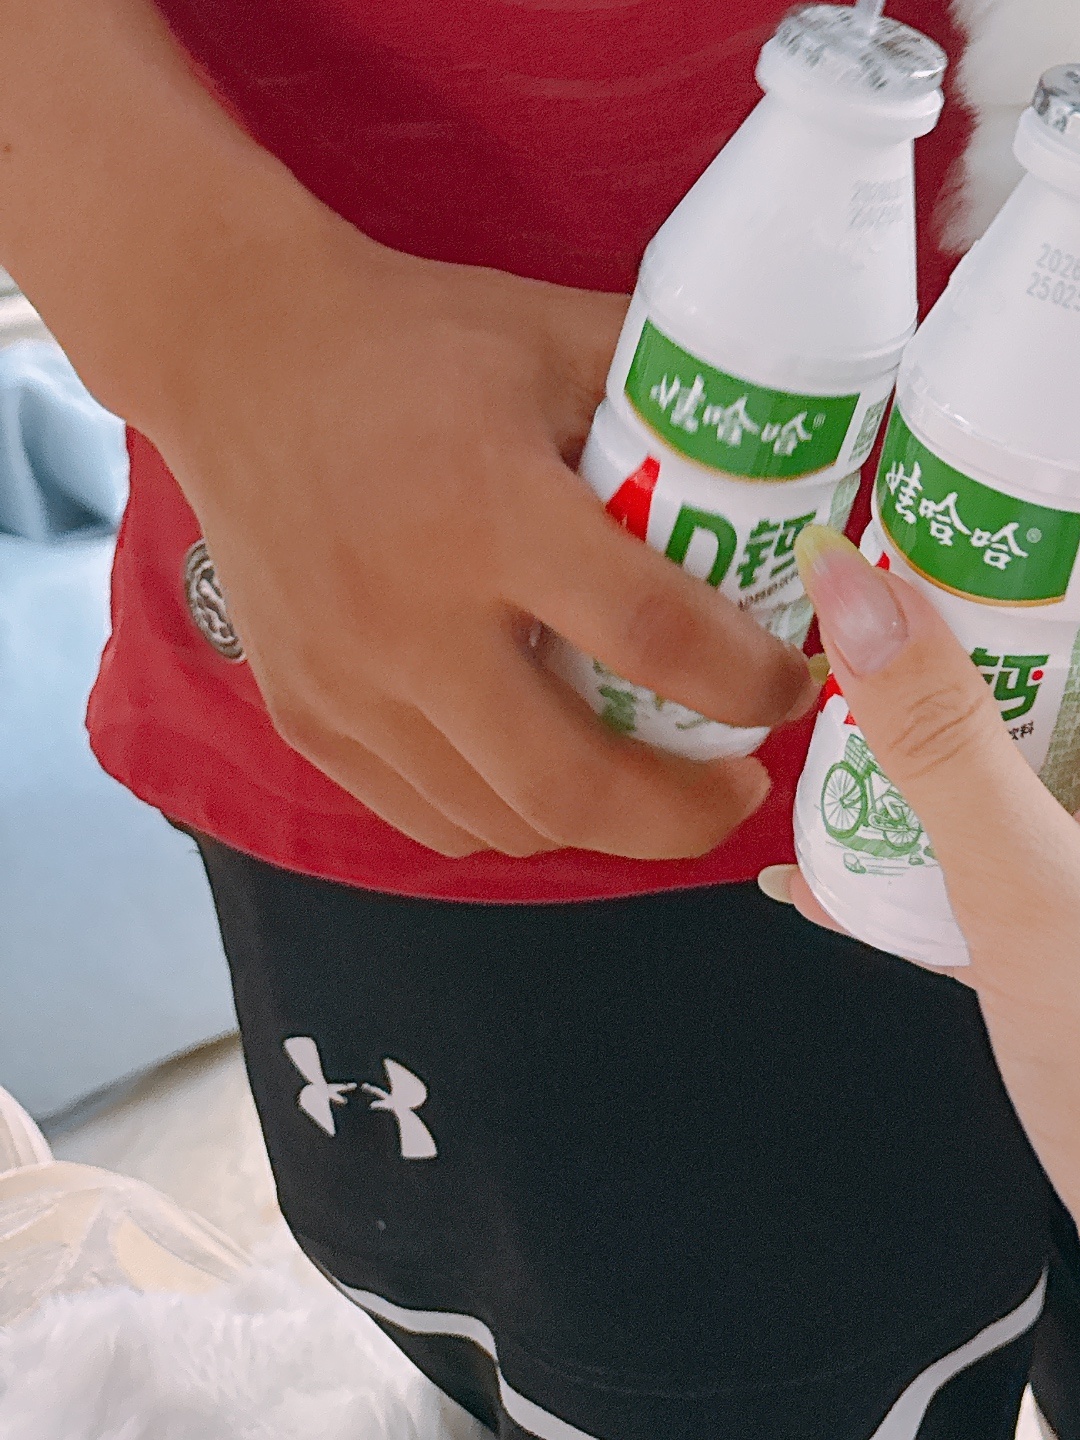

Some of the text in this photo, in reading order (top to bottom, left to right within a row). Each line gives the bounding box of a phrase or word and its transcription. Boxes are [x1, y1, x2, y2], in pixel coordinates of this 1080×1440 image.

[649, 373, 812, 456] 娃哈哈
[885, 461, 1027, 570] 娃哈哈
